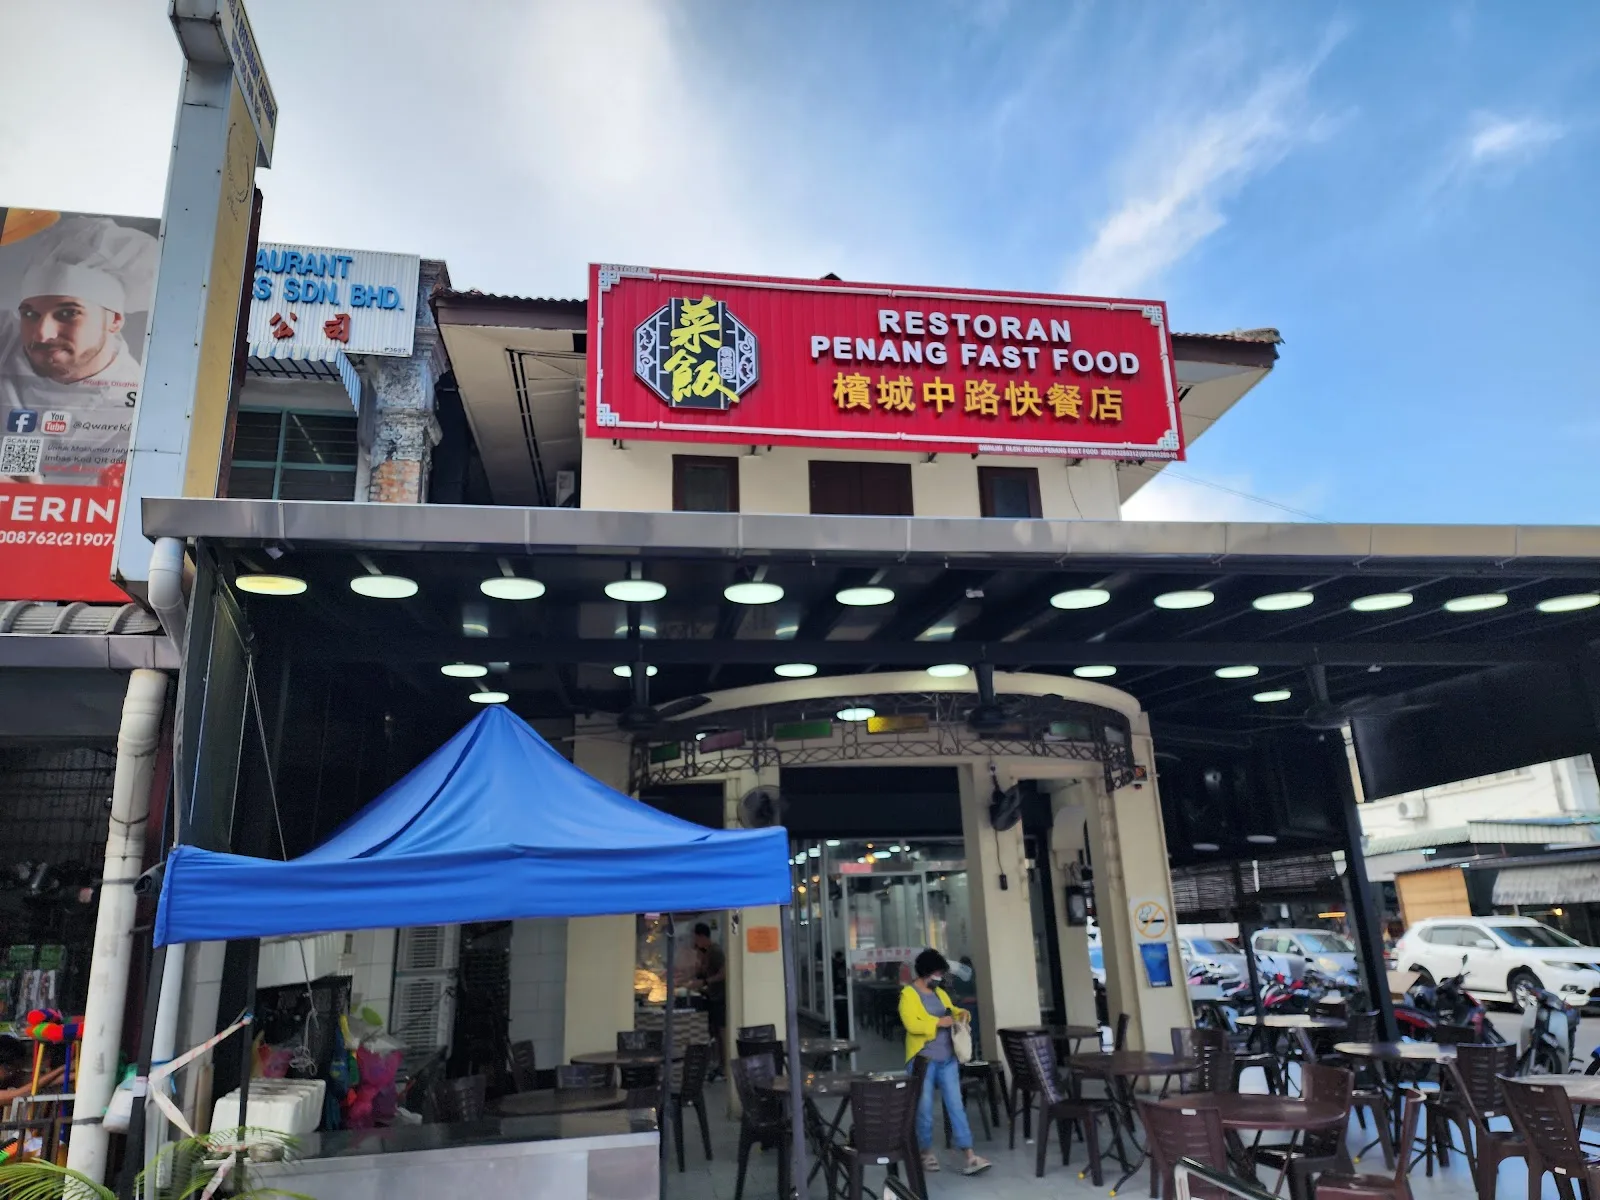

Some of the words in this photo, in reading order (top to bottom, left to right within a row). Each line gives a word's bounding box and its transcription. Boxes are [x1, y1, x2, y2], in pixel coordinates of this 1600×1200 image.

[283, 278, 339, 306] SDN.
[350, 284, 405, 311] BHD.
[269, 312, 351, 344] 公司
[878, 309, 1072, 343] RESTORAN
[810, 335, 948, 365] PENANG
[961, 343, 1040, 370] FAST
[1053, 348, 1140, 375] FOOD
[833, 372, 1123, 421] 檳城中路快餐店
[46, 422, 65, 431] Tube
[51, 412, 65, 421] You
